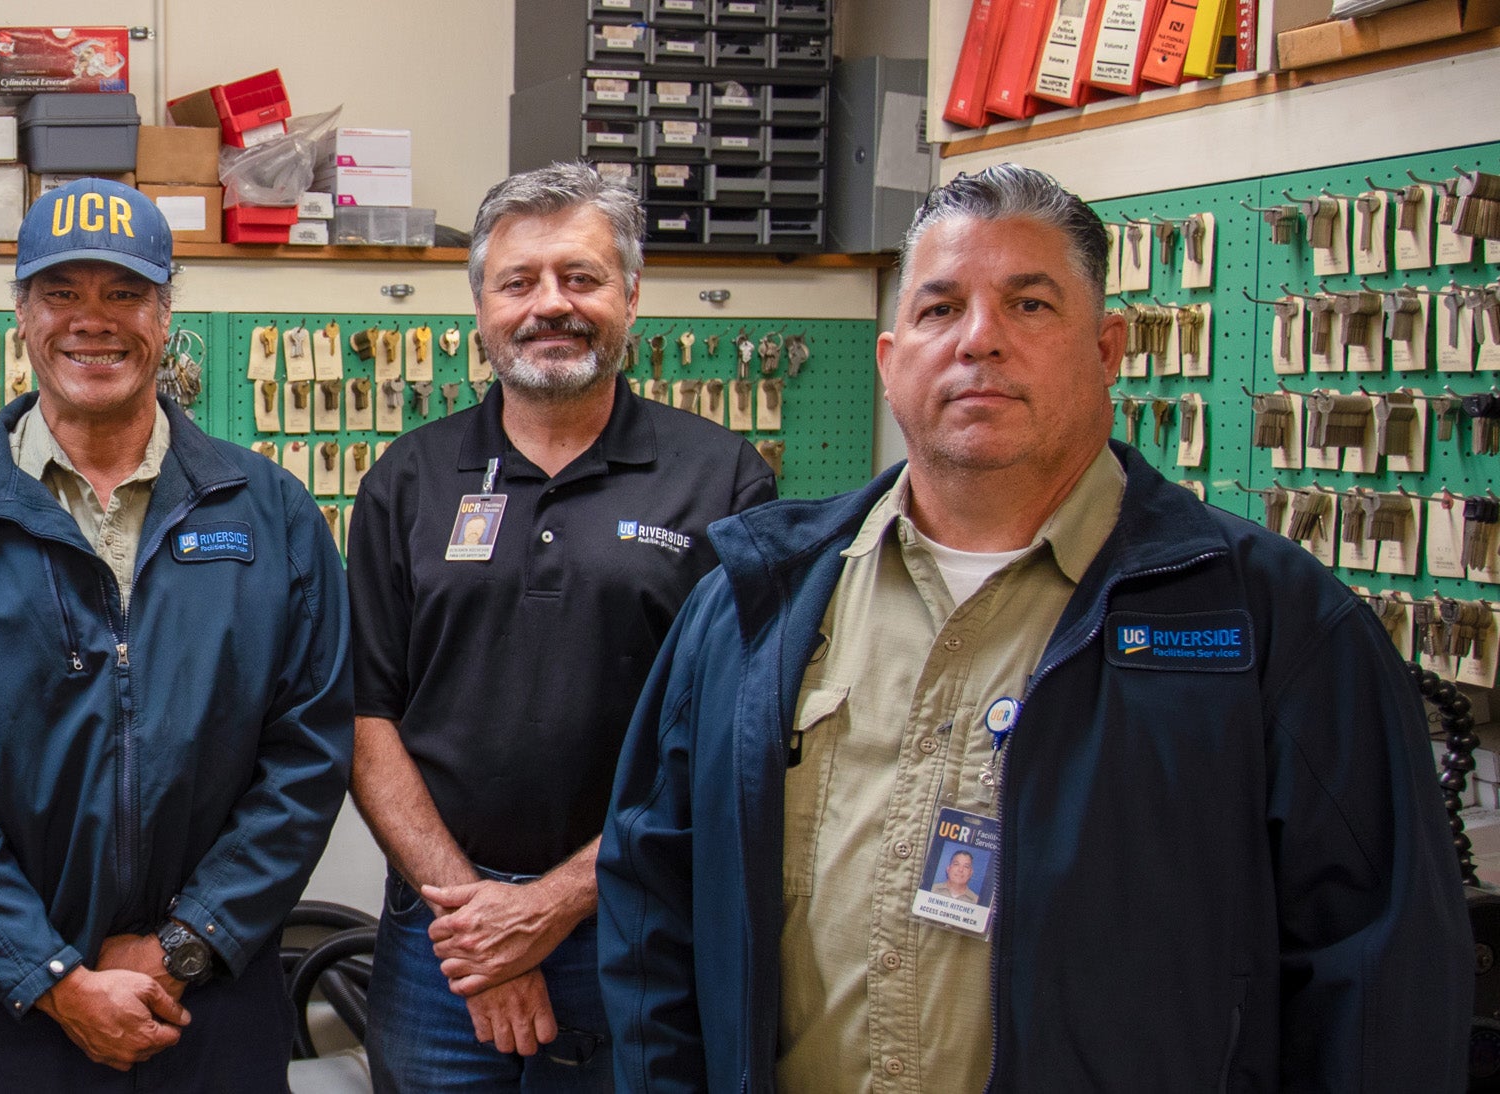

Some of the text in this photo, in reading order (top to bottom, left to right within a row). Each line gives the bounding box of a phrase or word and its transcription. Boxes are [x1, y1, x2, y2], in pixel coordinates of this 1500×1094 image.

[1112, 10, 1133, 18] Padlock
[1158, 33, 1185, 44] NATIONAL
[1104, 42, 1123, 50] Volume
[1152, 47, 1182, 58] HARDWARE
[1048, 56, 1066, 64] Volume
[0, 78, 39, 87] Cylindrical
[51, 192, 135, 238] UCR
[461, 502, 482, 513] UCR
[182, 531, 249, 546] UC RIVERSIDE
[620, 522, 690, 548] UC RIVERSIDE
[201, 544, 248, 552] Facilities Services
[1123, 629, 1242, 647] UC RIVERSIDE
[1152, 648, 1240, 658] Facilities Services
[991, 709, 1010, 722] UCR
[939, 821, 971, 843] UCR
[975, 838, 998, 850] Service
[927, 896, 975, 915] DENNIS RITCHEY
[919, 905, 939, 916] ACCESS
[939, 910, 961, 922] CONTROL
